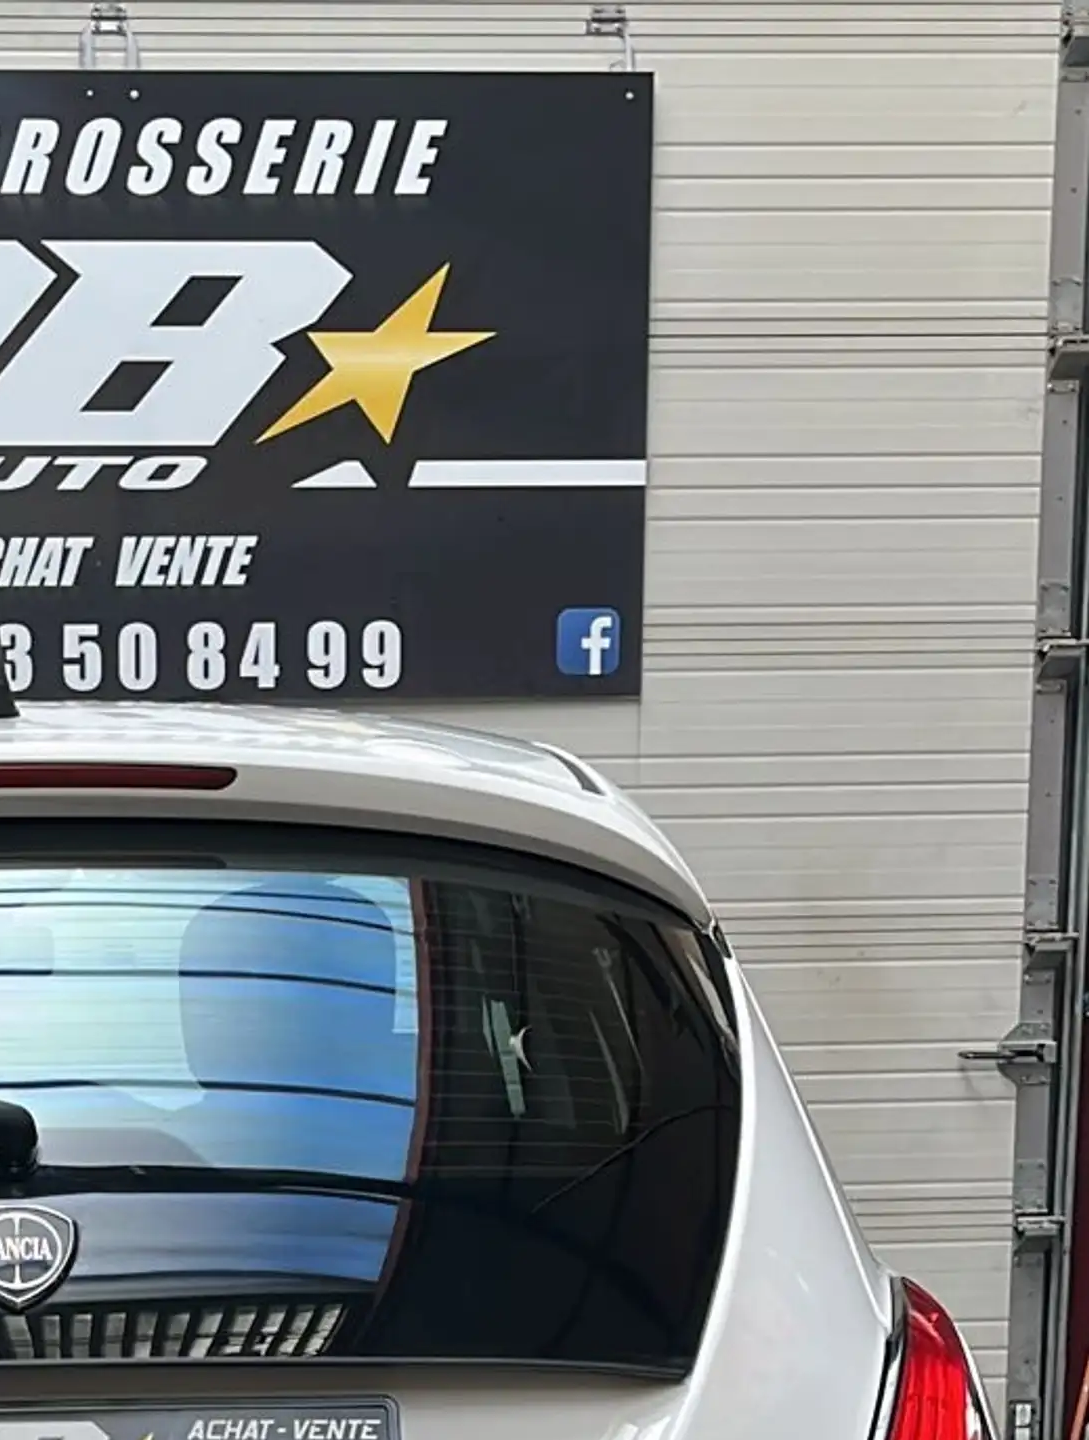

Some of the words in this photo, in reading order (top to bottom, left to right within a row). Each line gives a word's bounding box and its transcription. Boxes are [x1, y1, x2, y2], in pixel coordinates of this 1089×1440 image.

[115, 536, 258, 587] VENTE
[63, 622, 158, 692] 50
[187, 621, 280, 690] 84
[307, 620, 402, 690] 99
